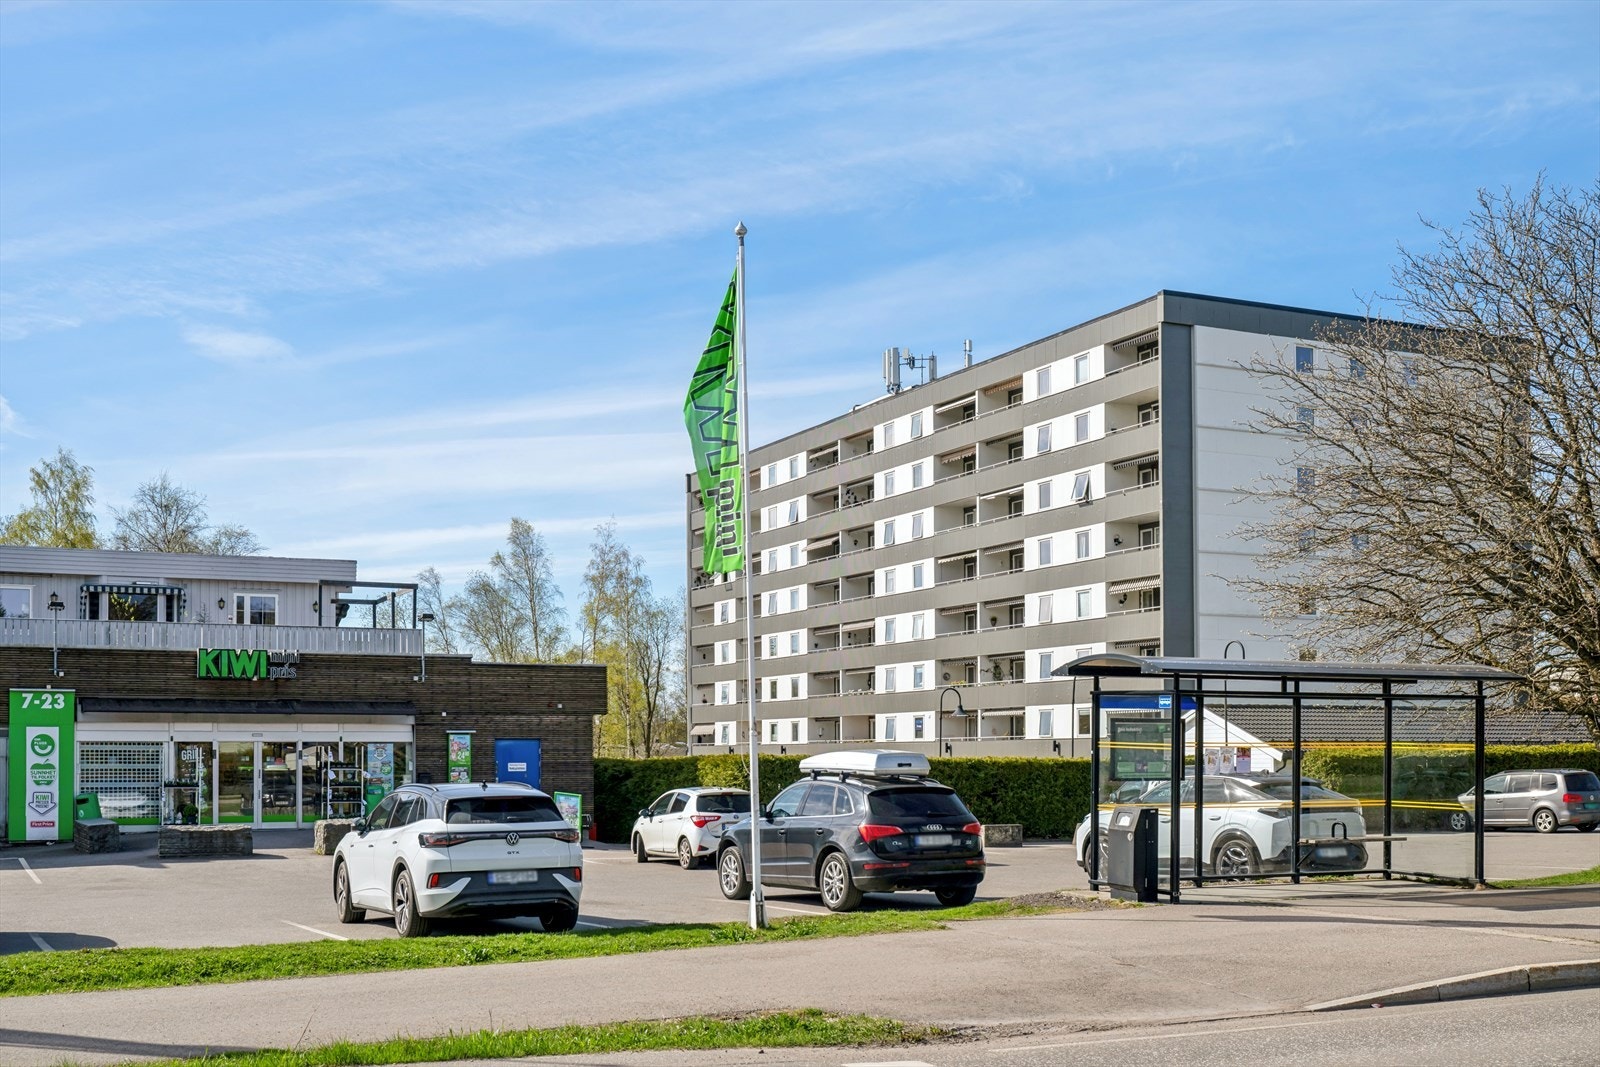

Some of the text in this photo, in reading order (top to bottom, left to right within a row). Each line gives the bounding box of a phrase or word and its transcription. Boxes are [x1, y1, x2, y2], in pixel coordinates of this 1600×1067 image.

[719, 478, 742, 557] mini
[198, 648, 268, 679] KIWI
[269, 648, 300, 664] mini
[268, 662, 297, 680] pris
[21, 693, 65, 709] 7-23
